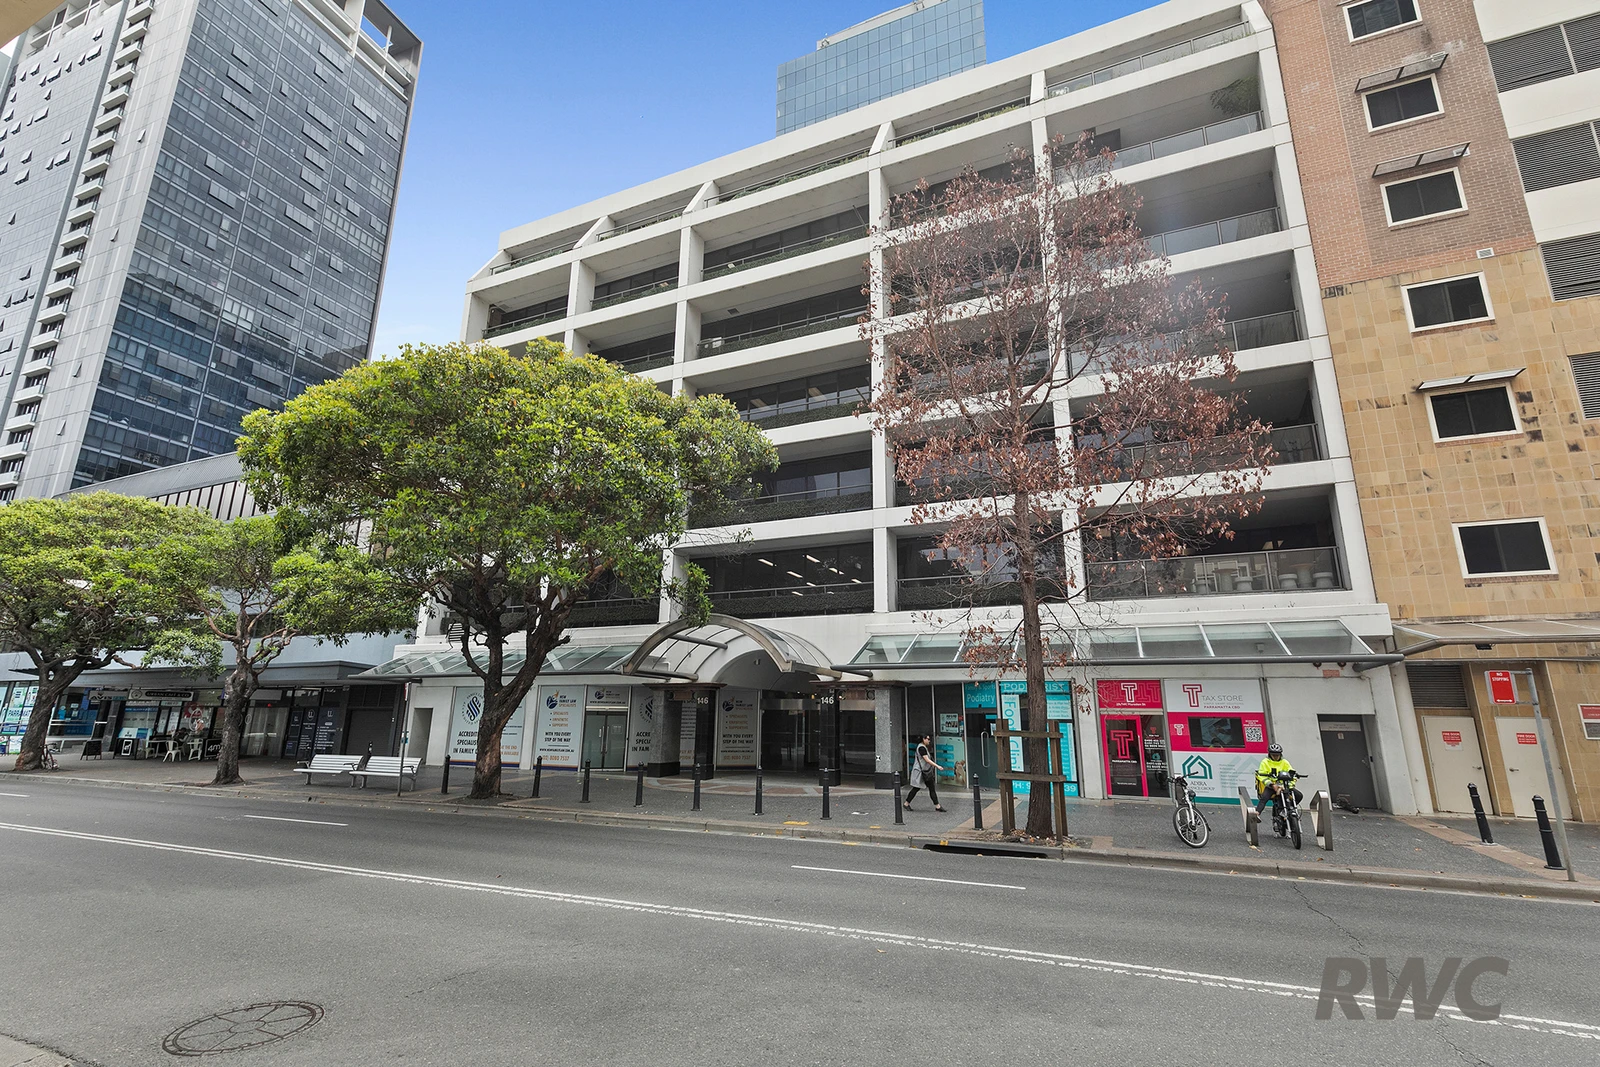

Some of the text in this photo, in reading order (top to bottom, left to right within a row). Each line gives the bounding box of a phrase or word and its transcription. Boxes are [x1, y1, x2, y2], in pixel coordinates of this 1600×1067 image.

[820, 696, 835, 705] 146
[966, 694, 995, 704] Podiatry
[1121, 683, 1137, 702] T
[1182, 684, 1202, 707] T
[1110, 730, 1134, 759] T
